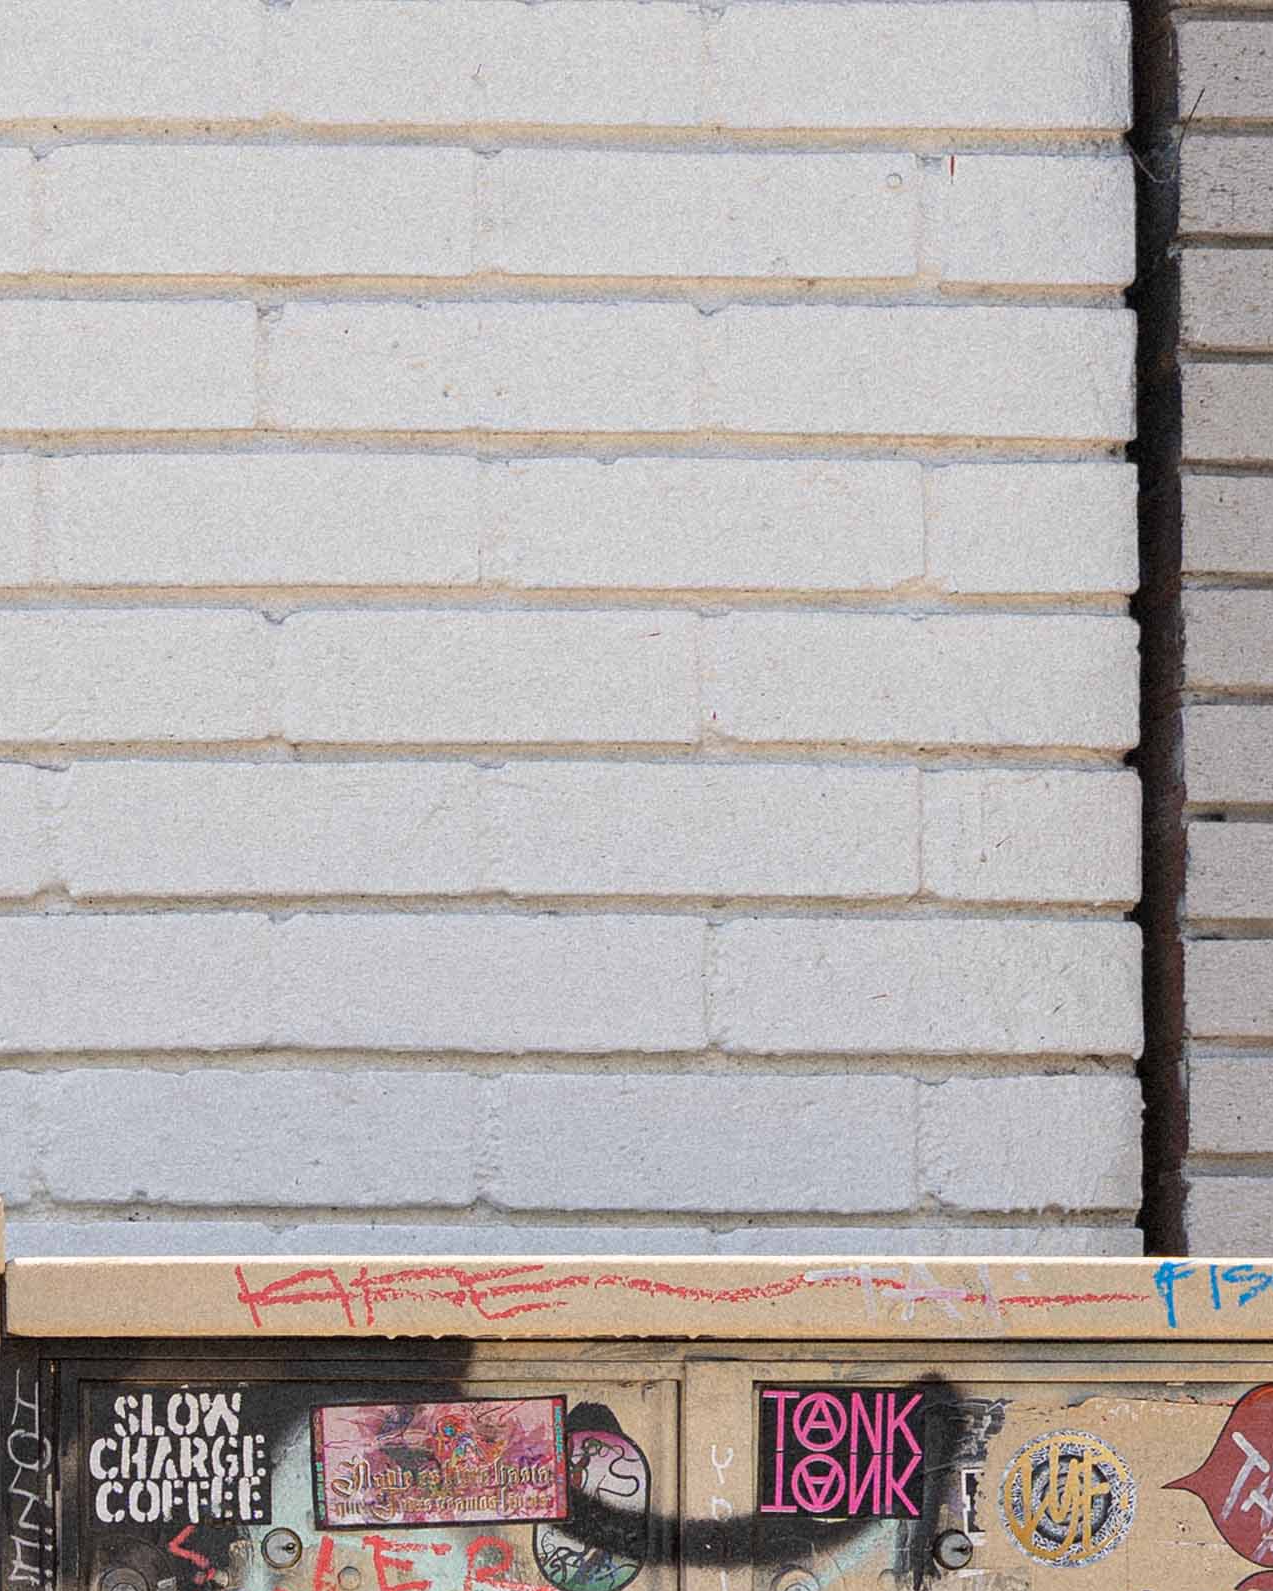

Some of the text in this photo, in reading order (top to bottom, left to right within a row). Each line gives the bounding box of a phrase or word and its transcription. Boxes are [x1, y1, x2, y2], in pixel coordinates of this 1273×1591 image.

[114, 1393, 242, 1435] SLOW
[90, 1435, 265, 1480] CHARGE
[95, 1477, 264, 1523] COFFEE
